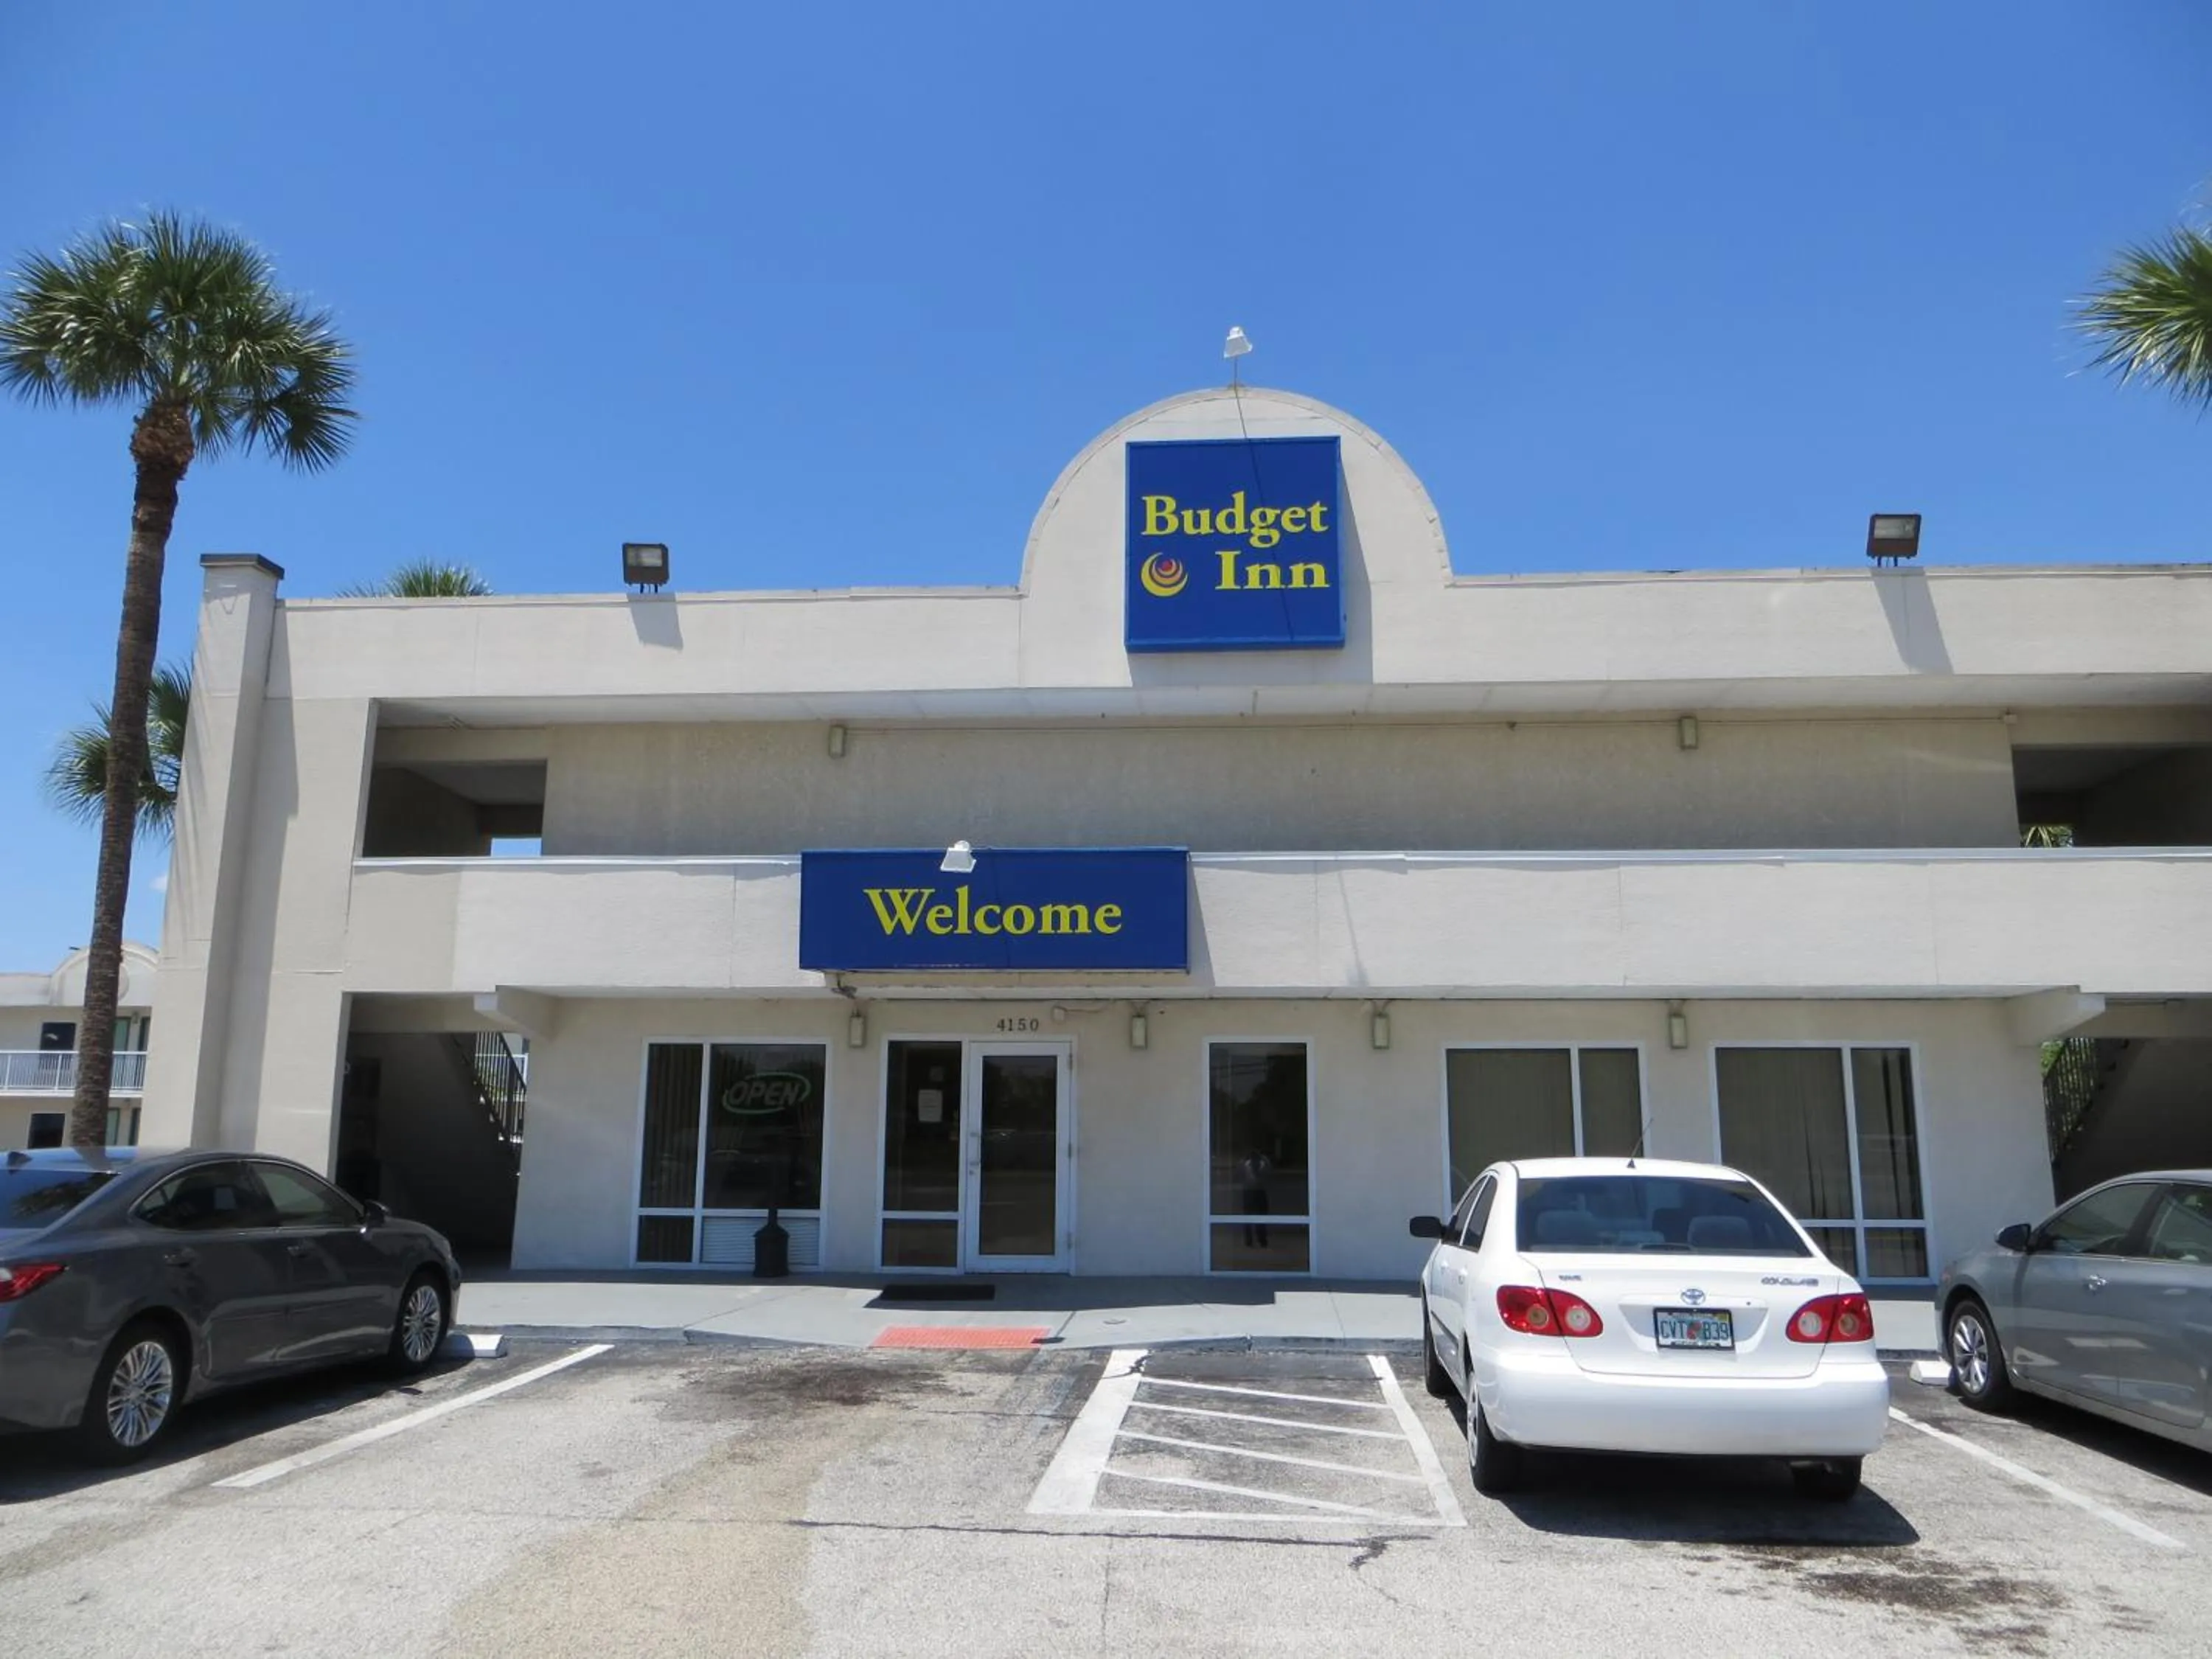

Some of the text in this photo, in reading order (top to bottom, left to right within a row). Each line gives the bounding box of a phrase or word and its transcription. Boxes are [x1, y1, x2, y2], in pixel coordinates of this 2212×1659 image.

[1141, 491, 1328, 548] Budget
[1215, 551, 1330, 590] Inn
[863, 885, 1122, 935] Welcome
[997, 1018, 1039, 1032] 4150
[729, 1081, 800, 1106] OPEN
